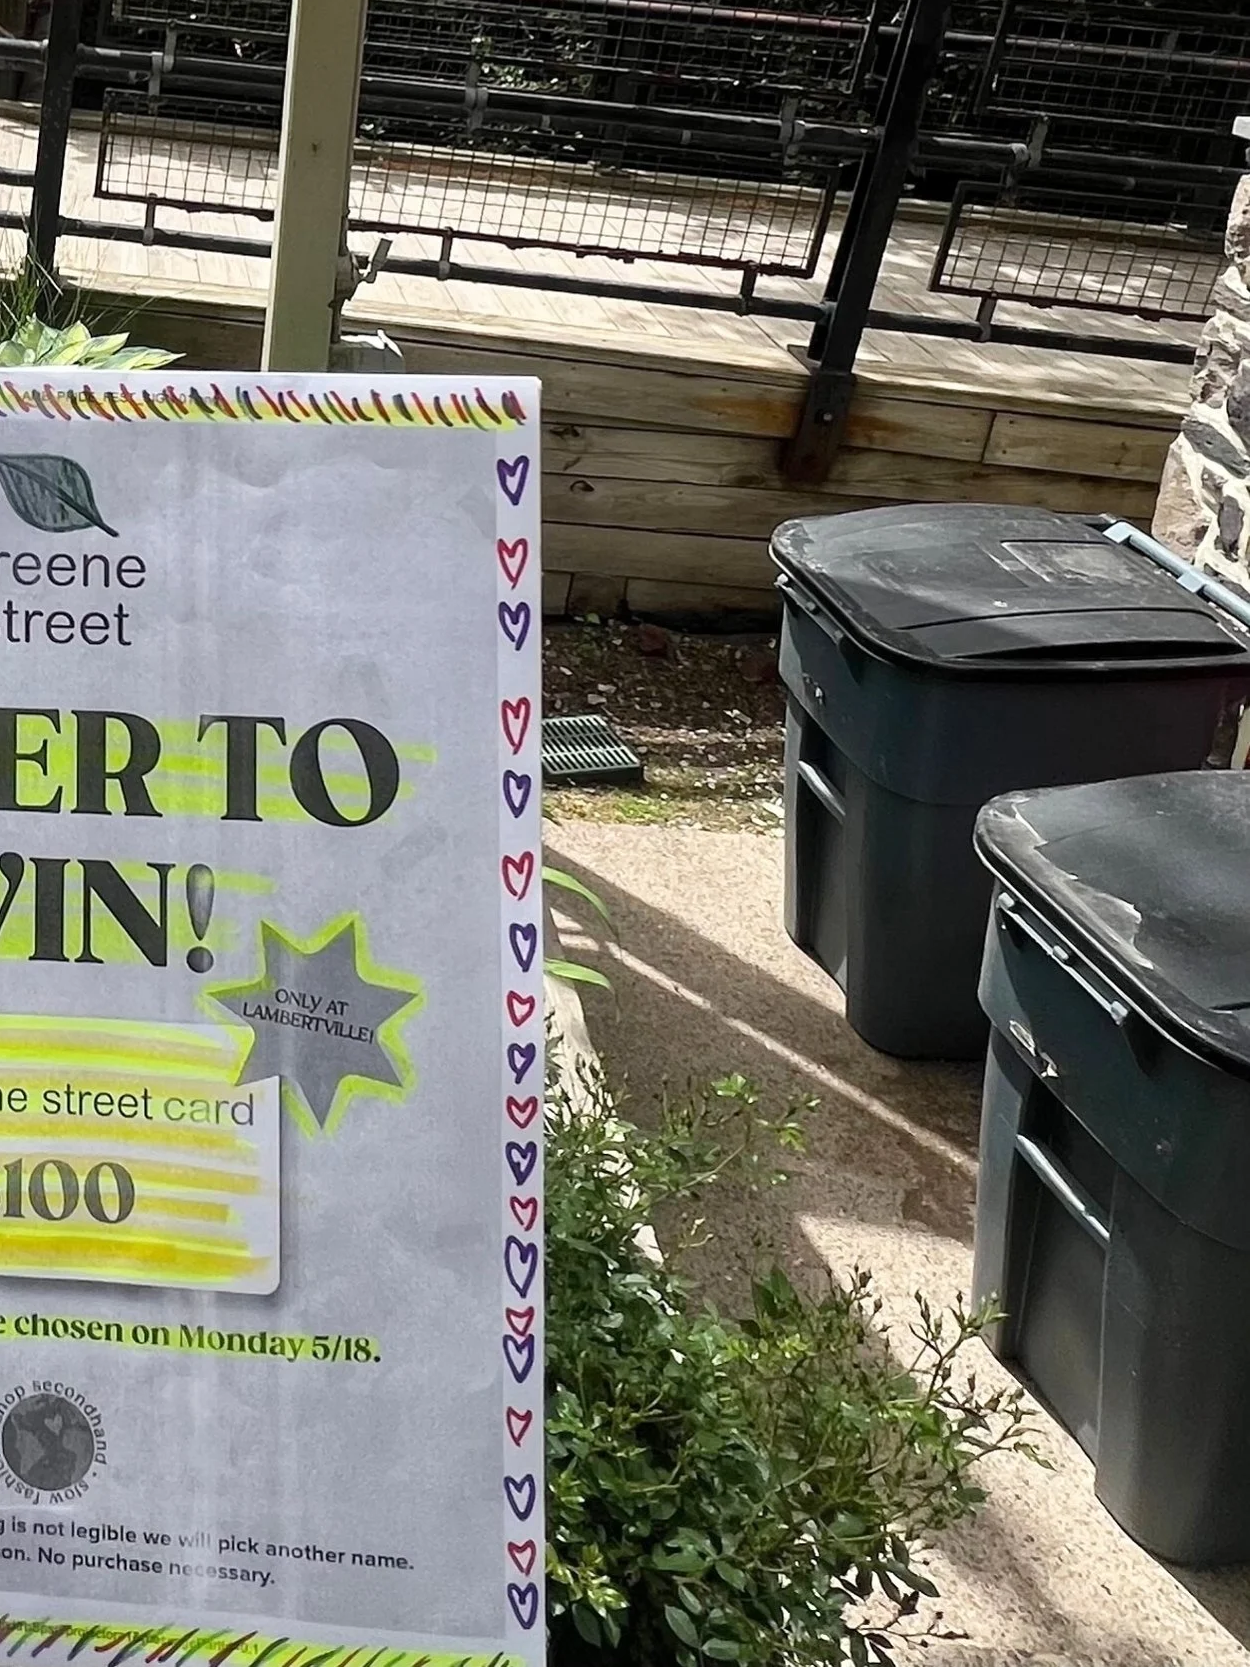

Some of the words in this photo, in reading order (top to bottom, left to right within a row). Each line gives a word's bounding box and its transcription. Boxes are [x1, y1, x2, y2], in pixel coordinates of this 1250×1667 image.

[196, 713, 401, 827] TO
[275, 988, 323, 1014] ONLY
[325, 999, 350, 1017] AT
[42, 1083, 153, 1120] street
[163, 1092, 255, 1126] card
[13, 1312, 124, 1343] chosen
[131, 1323, 171, 1346] on
[179, 1323, 306, 1363] Monday
[311, 1334, 382, 1364] 5/18.
[32, 1380, 108, 1466] secondhand
[49, 1479, 90, 1505] slow
[11, 1514, 27, 1533] is
[33, 1521, 65, 1537] not
[71, 1520, 137, 1544] legible
[143, 1532, 172, 1547] we
[178, 1531, 212, 1550] will
[218, 1534, 259, 1555] pick
[265, 1542, 347, 1564] another
[351, 1551, 415, 1570] name.
[37, 1546, 66, 1565] No
[71, 1552, 164, 1574] purchase
[169, 1561, 276, 1588] necessary.
